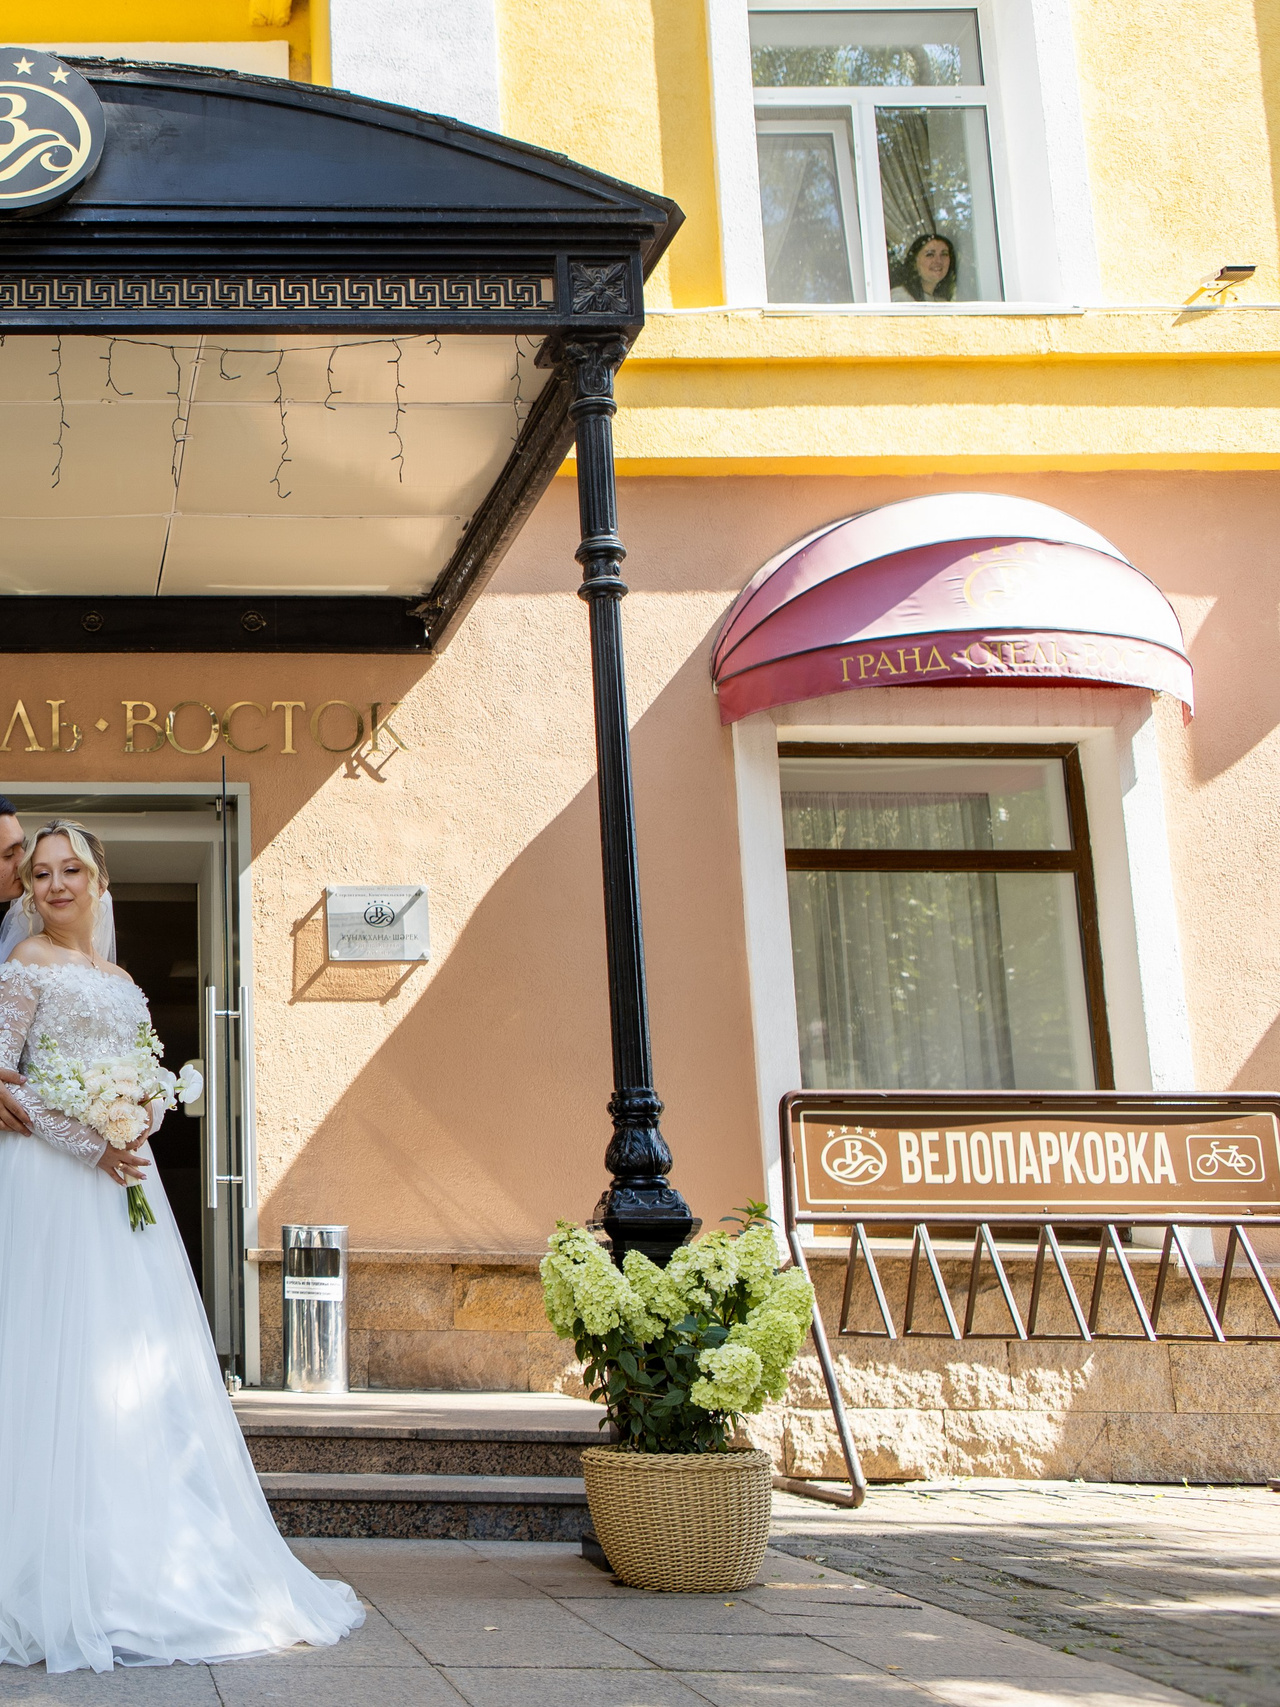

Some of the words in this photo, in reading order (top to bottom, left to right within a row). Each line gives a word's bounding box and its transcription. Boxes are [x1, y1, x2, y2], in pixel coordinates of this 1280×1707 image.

[840, 645, 951, 682] ГРАНД
[965, 641, 1068, 670] ОТЕЛЬ
[121, 700, 407, 755] ВОСТОК
[897, 1130, 1178, 1185] ВЕЛОПАРКОВКА
